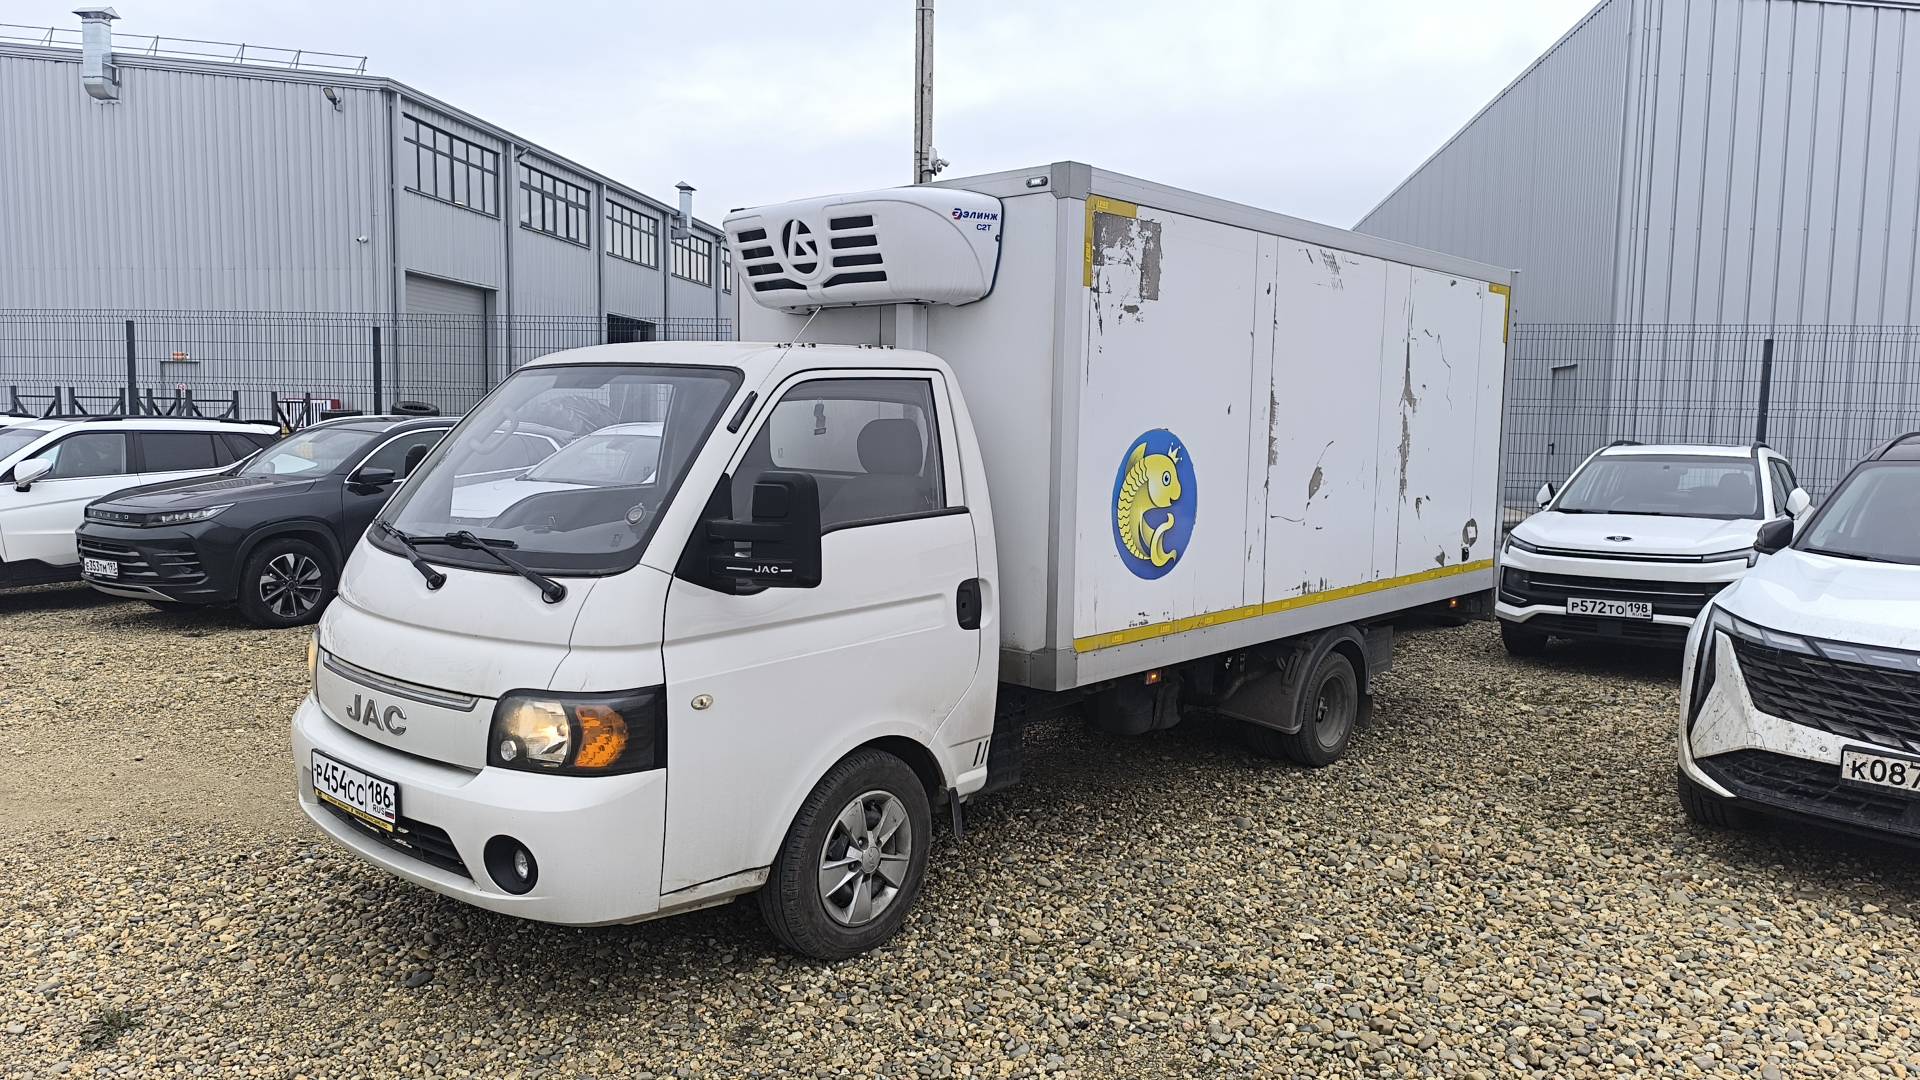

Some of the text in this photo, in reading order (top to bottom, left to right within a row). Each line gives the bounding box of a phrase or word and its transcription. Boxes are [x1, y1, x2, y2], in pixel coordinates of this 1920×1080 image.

[754, 565, 779, 574] JAC
[1571, 599, 1648, 615] Р572ТО 198
[346, 693, 407, 737] JAC
[315, 762, 392, 809] Р454СС 186
[372, 804, 385, 816] RUS
